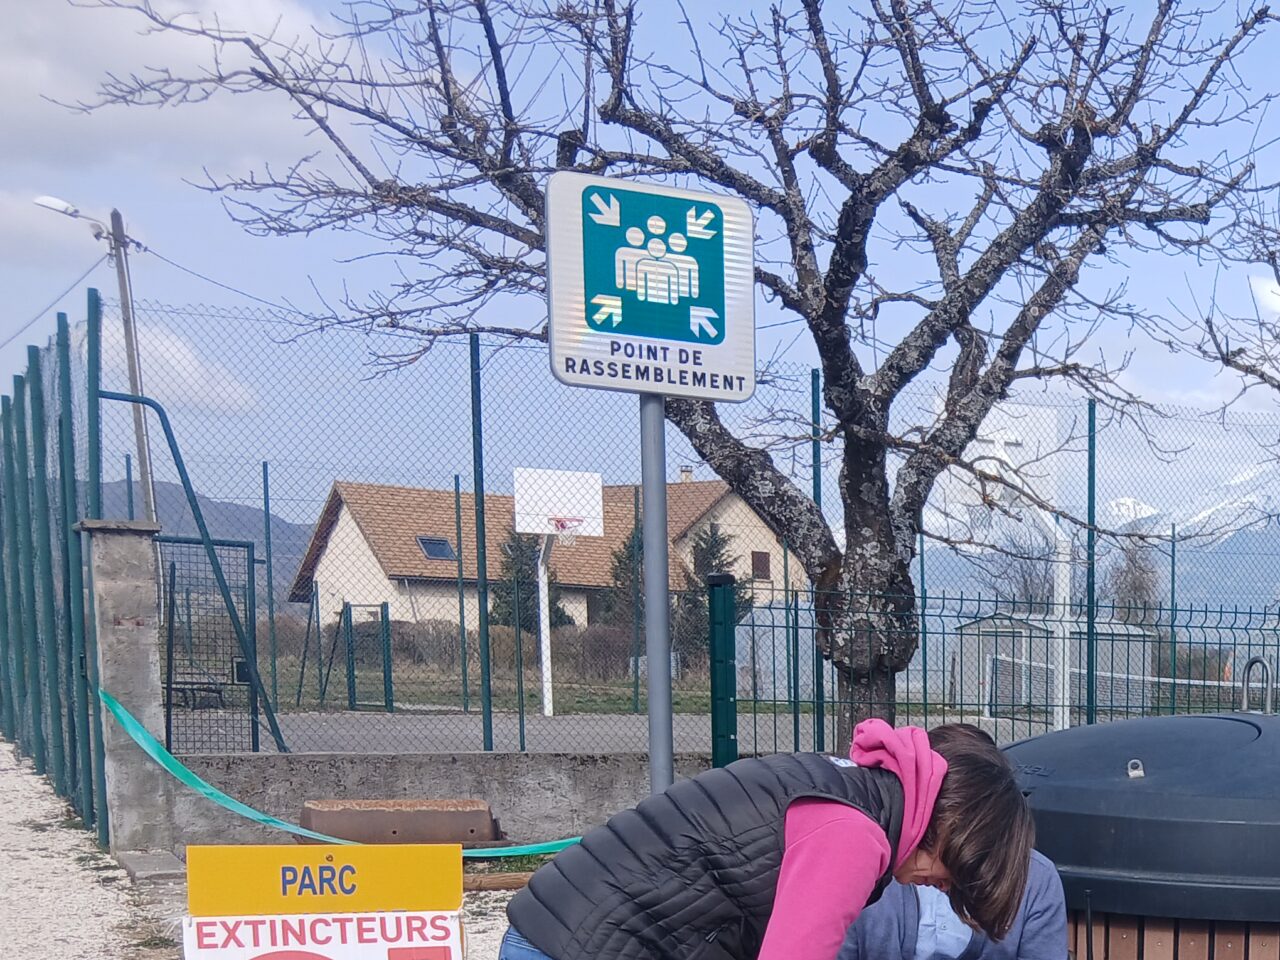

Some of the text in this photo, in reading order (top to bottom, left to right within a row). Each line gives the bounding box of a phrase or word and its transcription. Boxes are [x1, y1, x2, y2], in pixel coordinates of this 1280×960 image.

[610, 340, 703, 366] POINT DE
[565, 357, 746, 392] RASSEMBLEMENT
[281, 864, 357, 897] PARC
[196, 915, 451, 950] EXTINCTEURS
